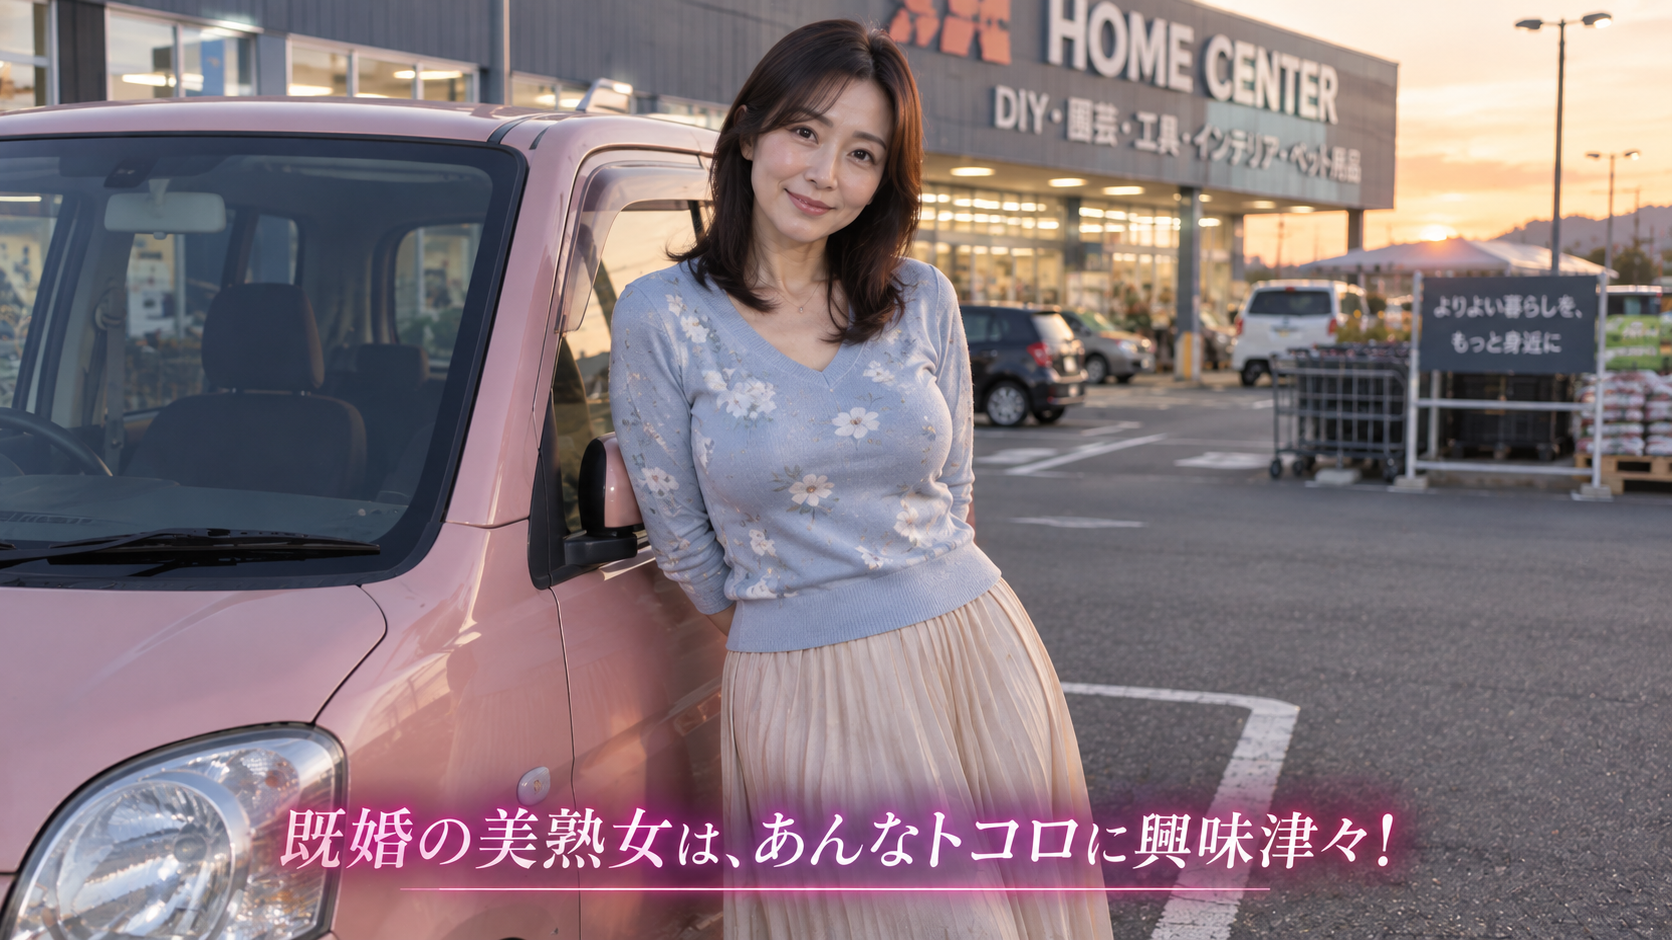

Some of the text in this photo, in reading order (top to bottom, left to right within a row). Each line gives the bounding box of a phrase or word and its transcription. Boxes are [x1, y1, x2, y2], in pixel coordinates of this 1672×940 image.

[1047, 0, 1338, 125] HOME CENTER
[1433, 294, 1583, 319] よりよい暮らしを、
[1451, 330, 1562, 355] もっと身近に
